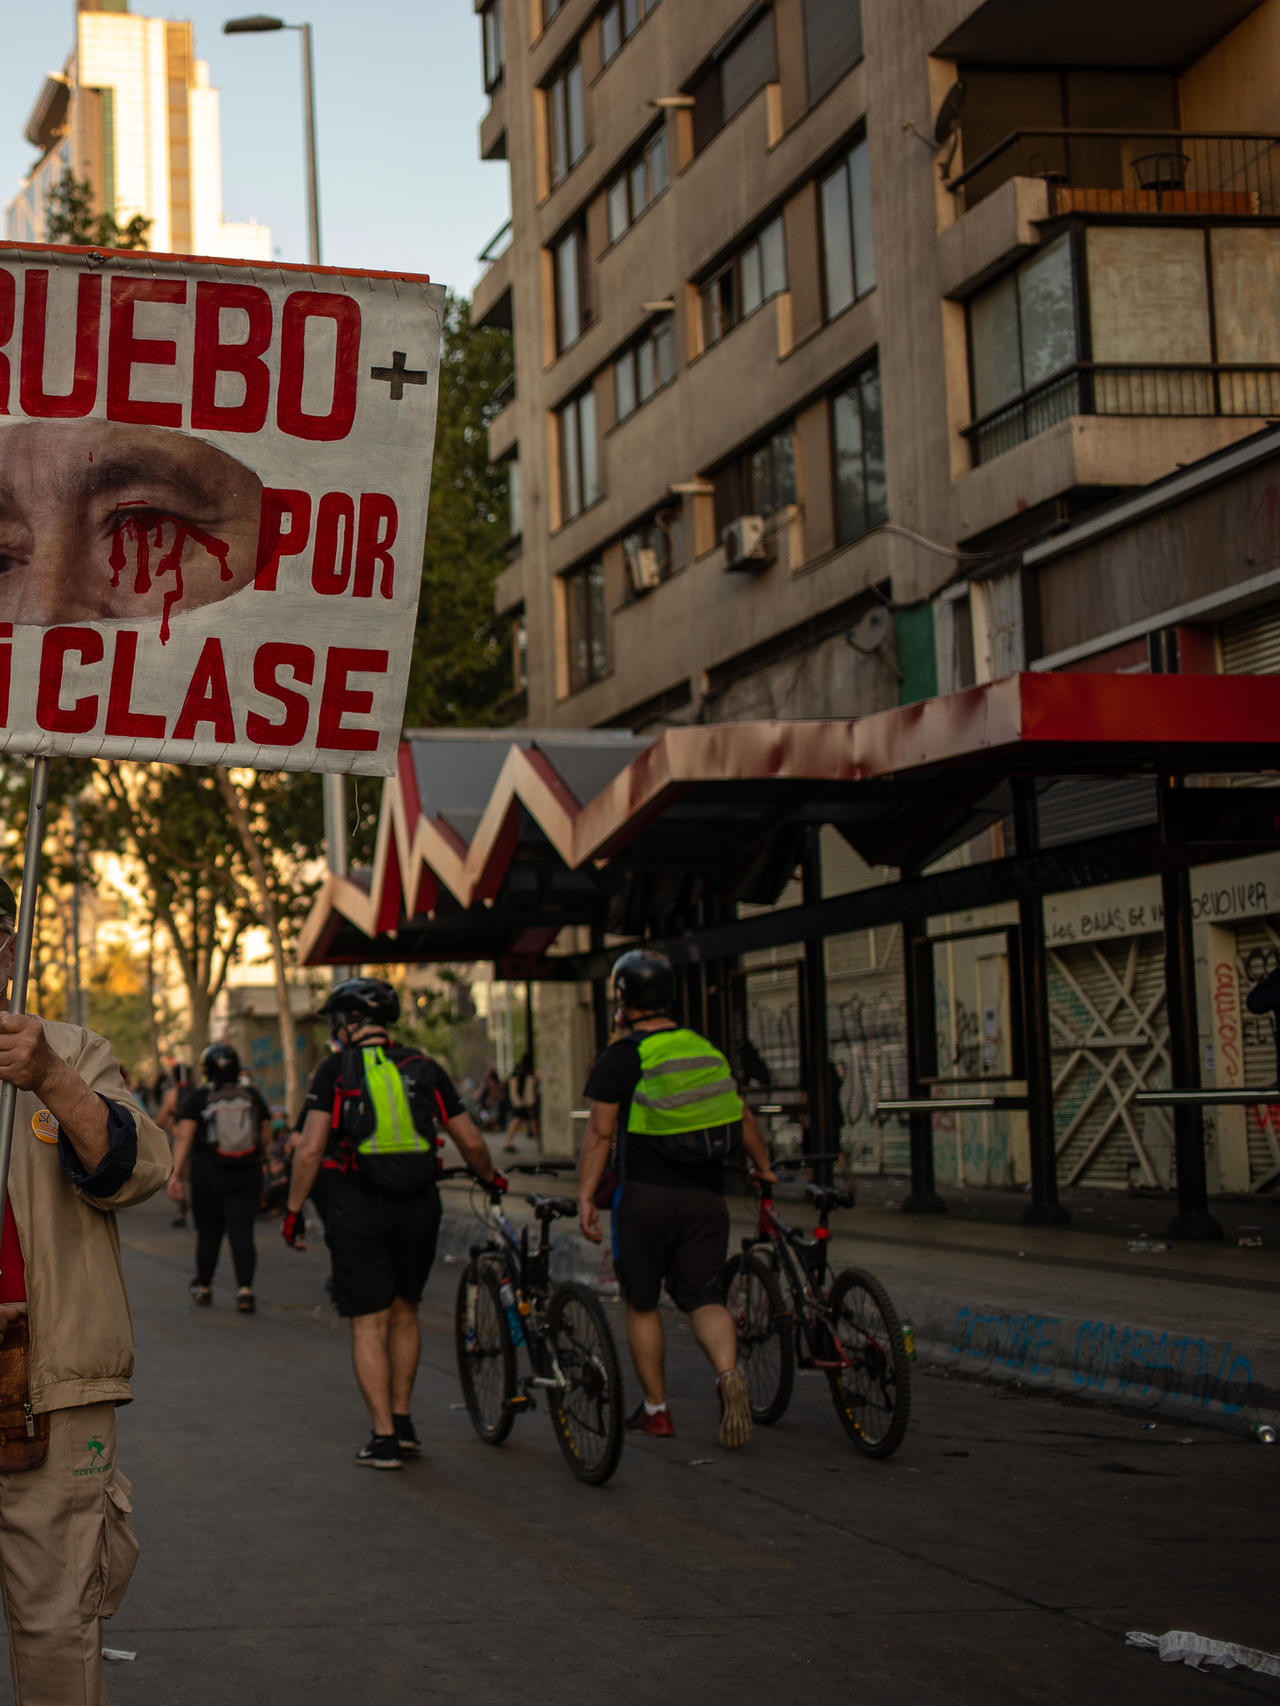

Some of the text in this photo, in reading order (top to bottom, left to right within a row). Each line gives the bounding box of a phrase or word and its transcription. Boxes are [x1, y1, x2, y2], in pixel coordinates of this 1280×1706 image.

[371, 352, 427, 400] +
[253, 487, 398, 599] POR
[36, 627, 388, 751] CLASE
[1074, 1321, 1252, 1414] COMBATIVO
